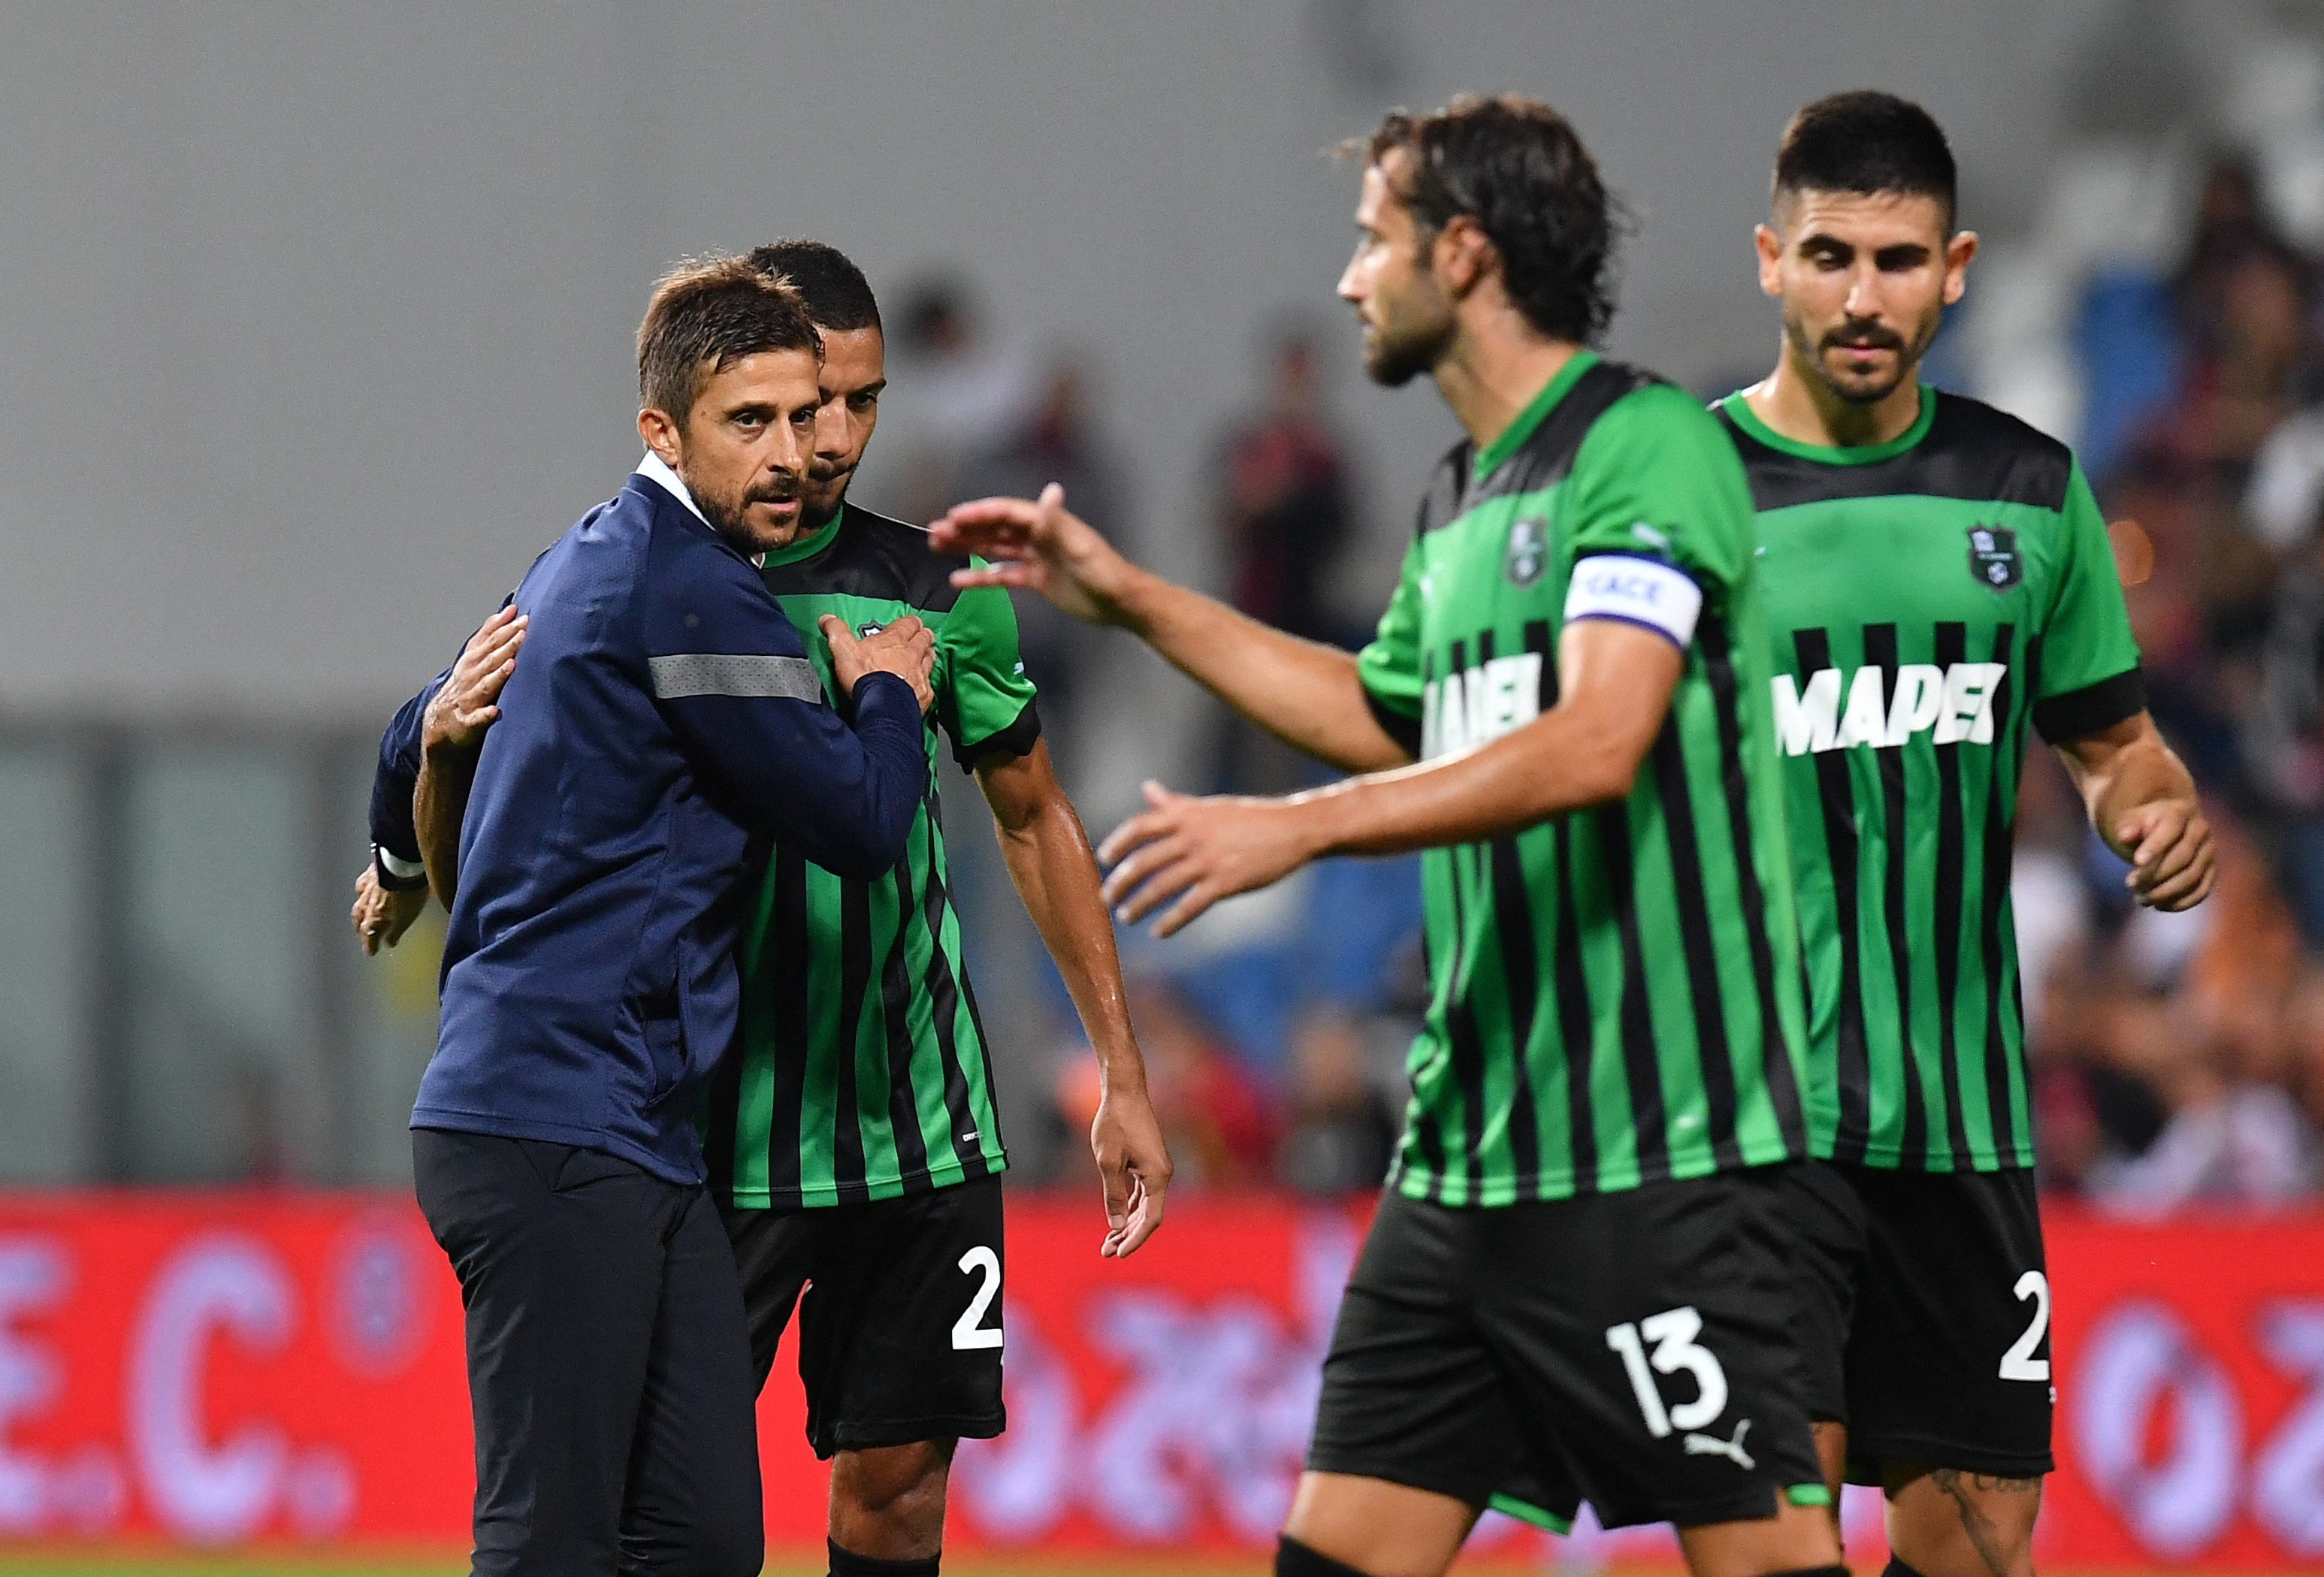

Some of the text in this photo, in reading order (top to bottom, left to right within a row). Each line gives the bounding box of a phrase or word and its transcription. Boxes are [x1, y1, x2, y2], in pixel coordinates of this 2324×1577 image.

[1770, 663, 2007, 756] MAPEI
[951, 1246, 1003, 1350] 2
[1998, 1270, 2050, 1381] 2
[1606, 1306, 1728, 1437] 13
